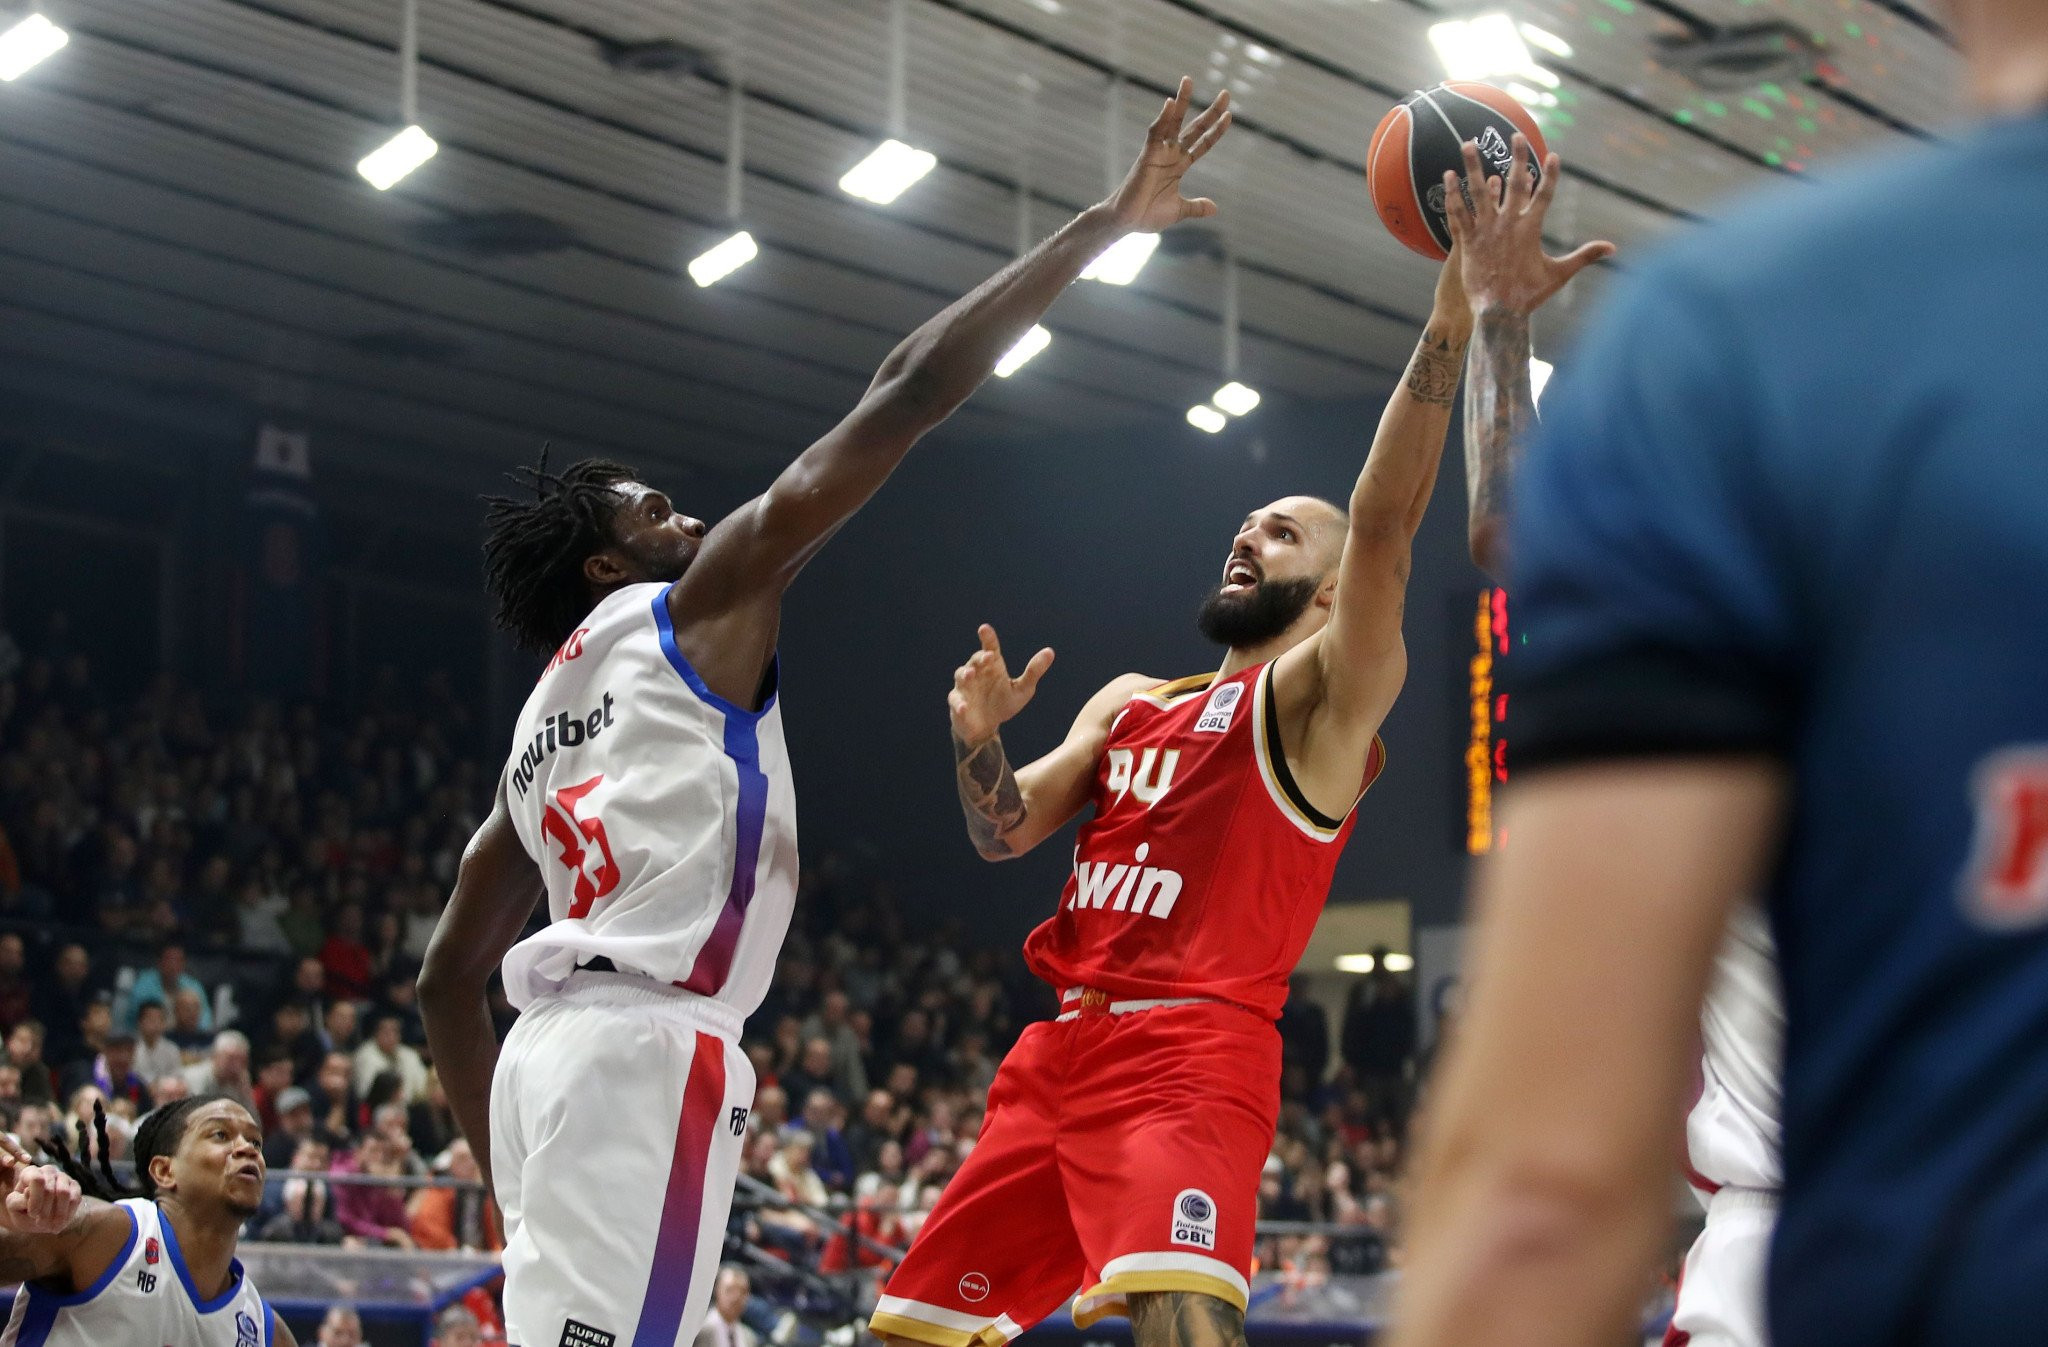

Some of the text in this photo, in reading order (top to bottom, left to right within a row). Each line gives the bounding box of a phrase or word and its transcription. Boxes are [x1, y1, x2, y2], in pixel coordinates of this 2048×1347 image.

[1199, 717, 1226, 729] GBL
[512, 691, 614, 802] novibet
[1107, 747, 1181, 811] 94
[541, 774, 620, 919] 35
[1175, 1229, 1211, 1246] GBL
[569, 1324, 610, 1346] SUPER
